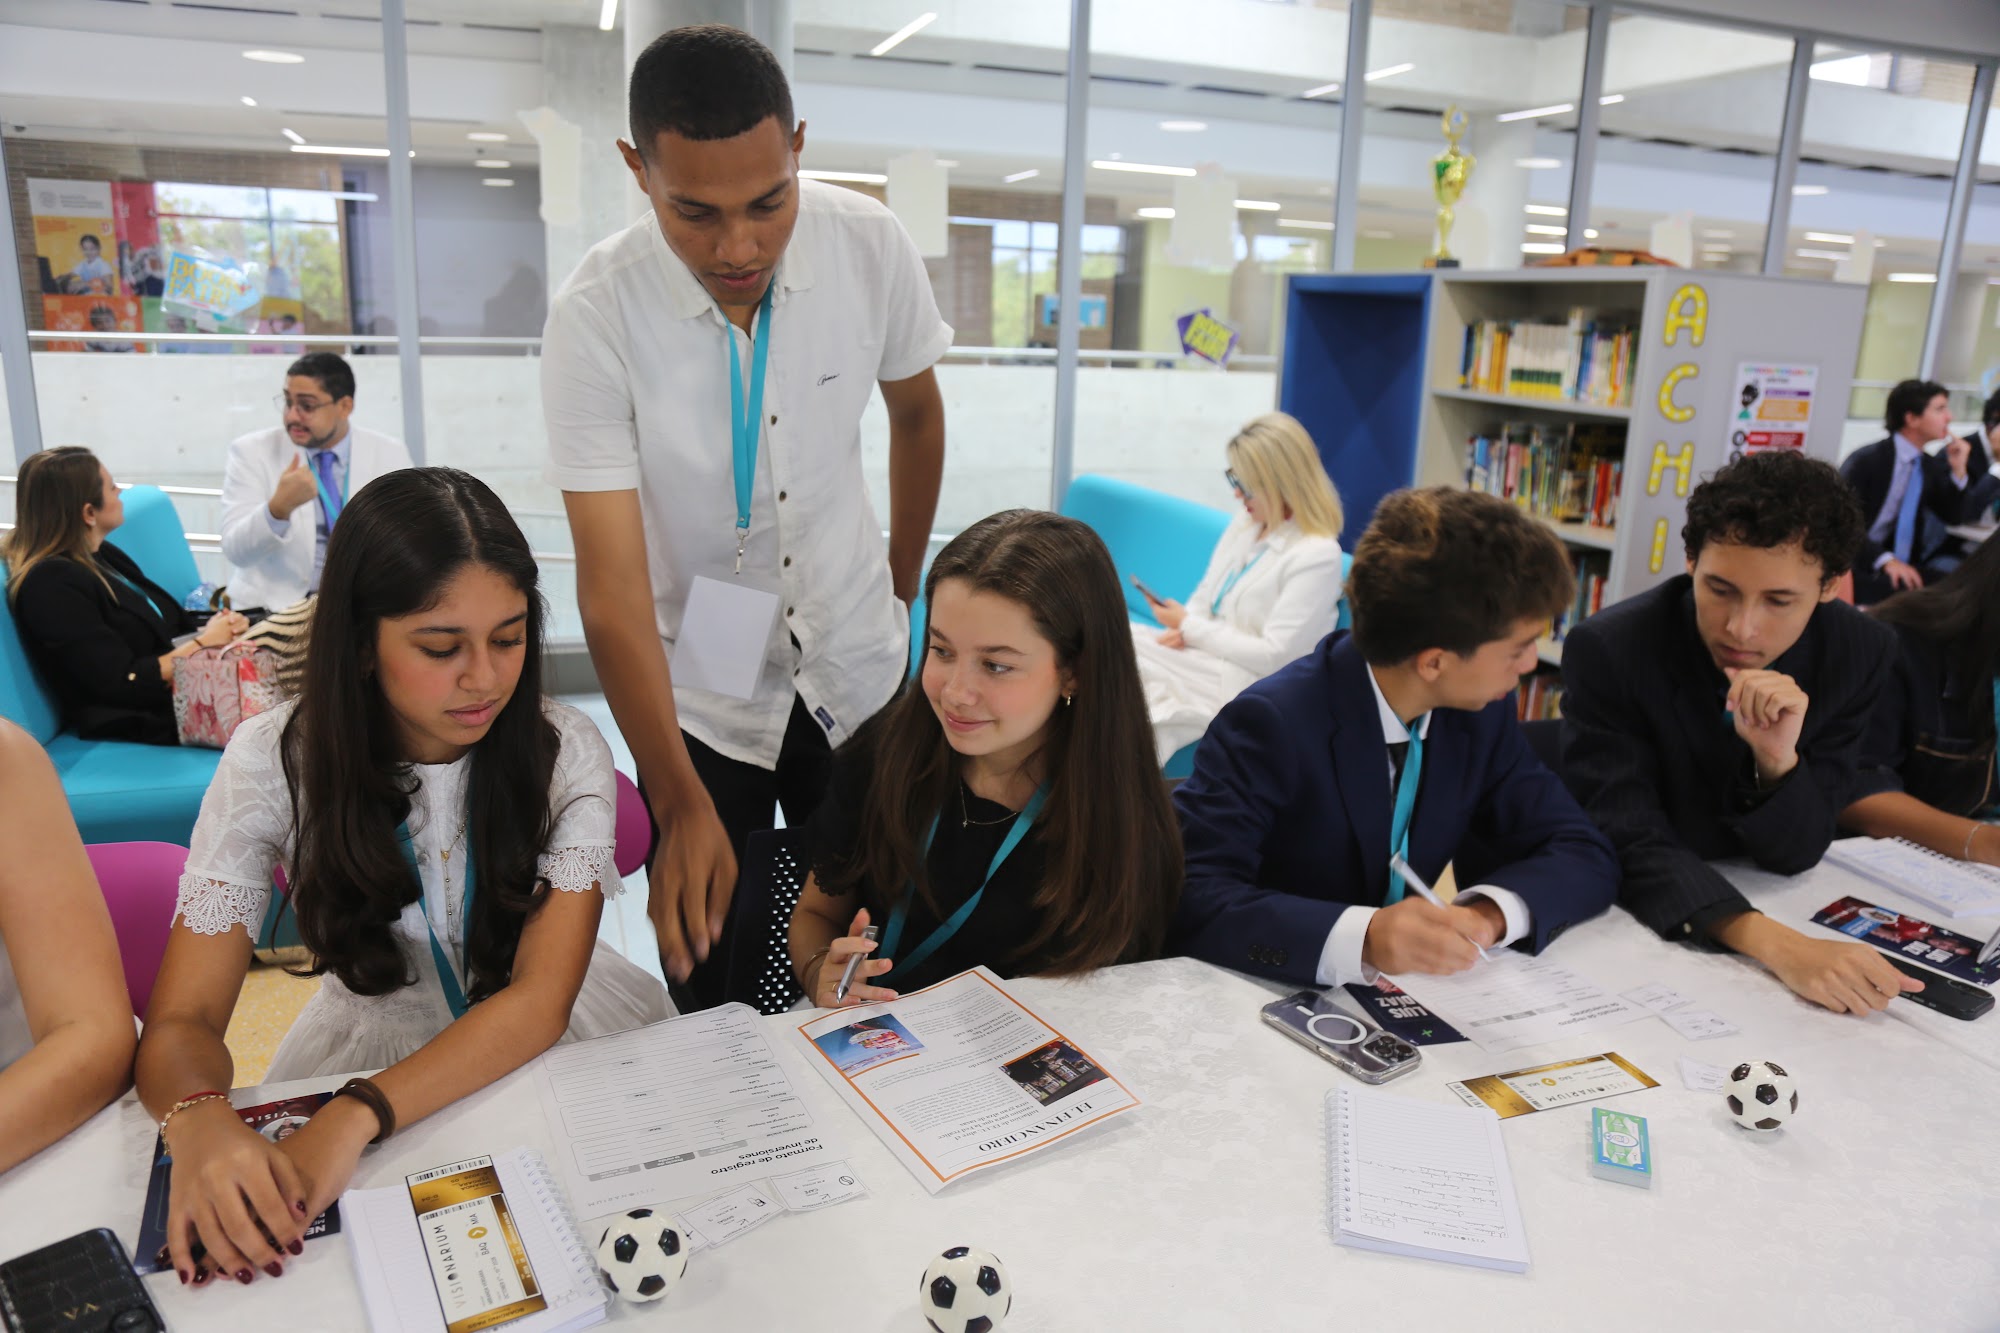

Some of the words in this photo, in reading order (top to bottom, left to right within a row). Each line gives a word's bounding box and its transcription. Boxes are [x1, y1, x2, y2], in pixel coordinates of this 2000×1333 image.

[1374, 995, 1416, 1008] DÍAZ
[1388, 1005, 1428, 1019] LUIS
[1068, 1101, 1094, 1115] EL
[976, 1111, 1074, 1154] FINANCIERO
[802, 1137, 818, 1146] de
[737, 1141, 802, 1161] inversiones
[772, 1143, 823, 1160] Formato
[709, 1158, 755, 1174] registro
[757, 1155, 773, 1164] de
[469, 1212, 479, 1224] MIA
[478, 1241, 490, 1255] BAQ
[432, 1223, 467, 1309] VISIONARIUM
